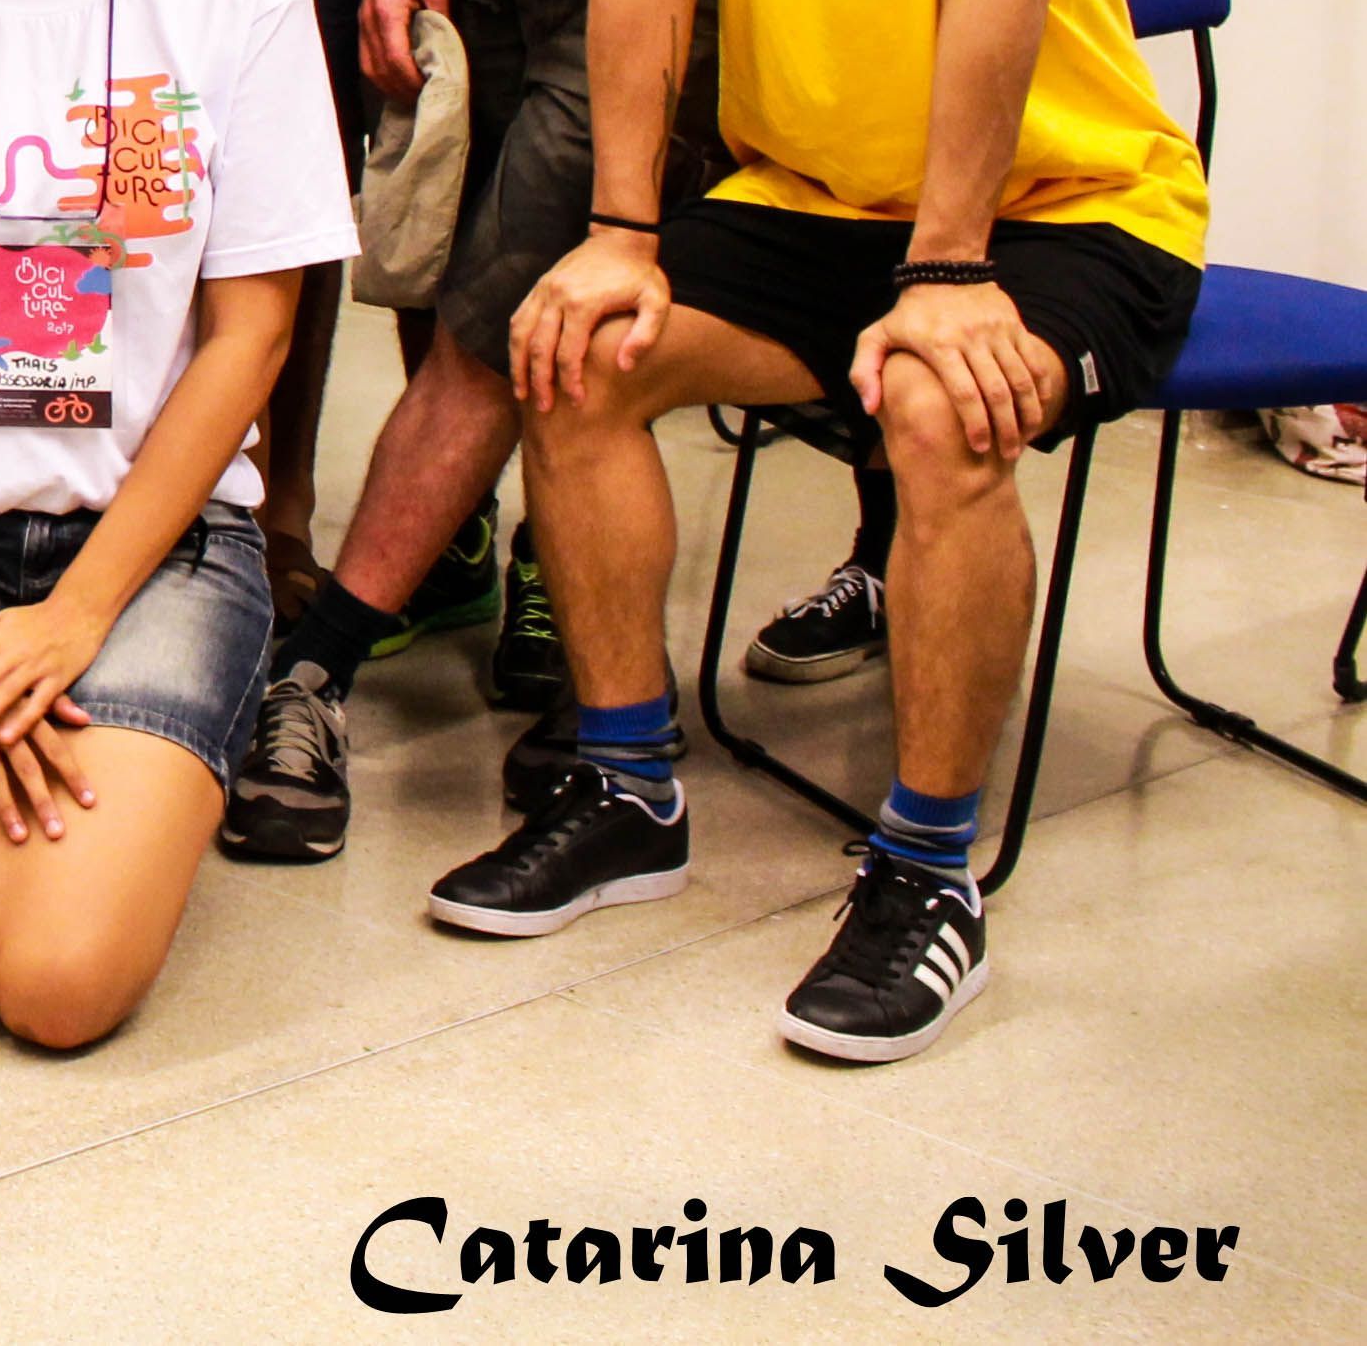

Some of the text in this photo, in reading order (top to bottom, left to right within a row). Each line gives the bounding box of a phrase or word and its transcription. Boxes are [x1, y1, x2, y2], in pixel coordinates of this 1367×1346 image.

[84, 105, 164, 147] BICI
[113, 147, 182, 173] CUL
[15, 256, 65, 284] BICI
[31, 283, 73, 301] CUL
[47, 322, 74, 335] 2017
